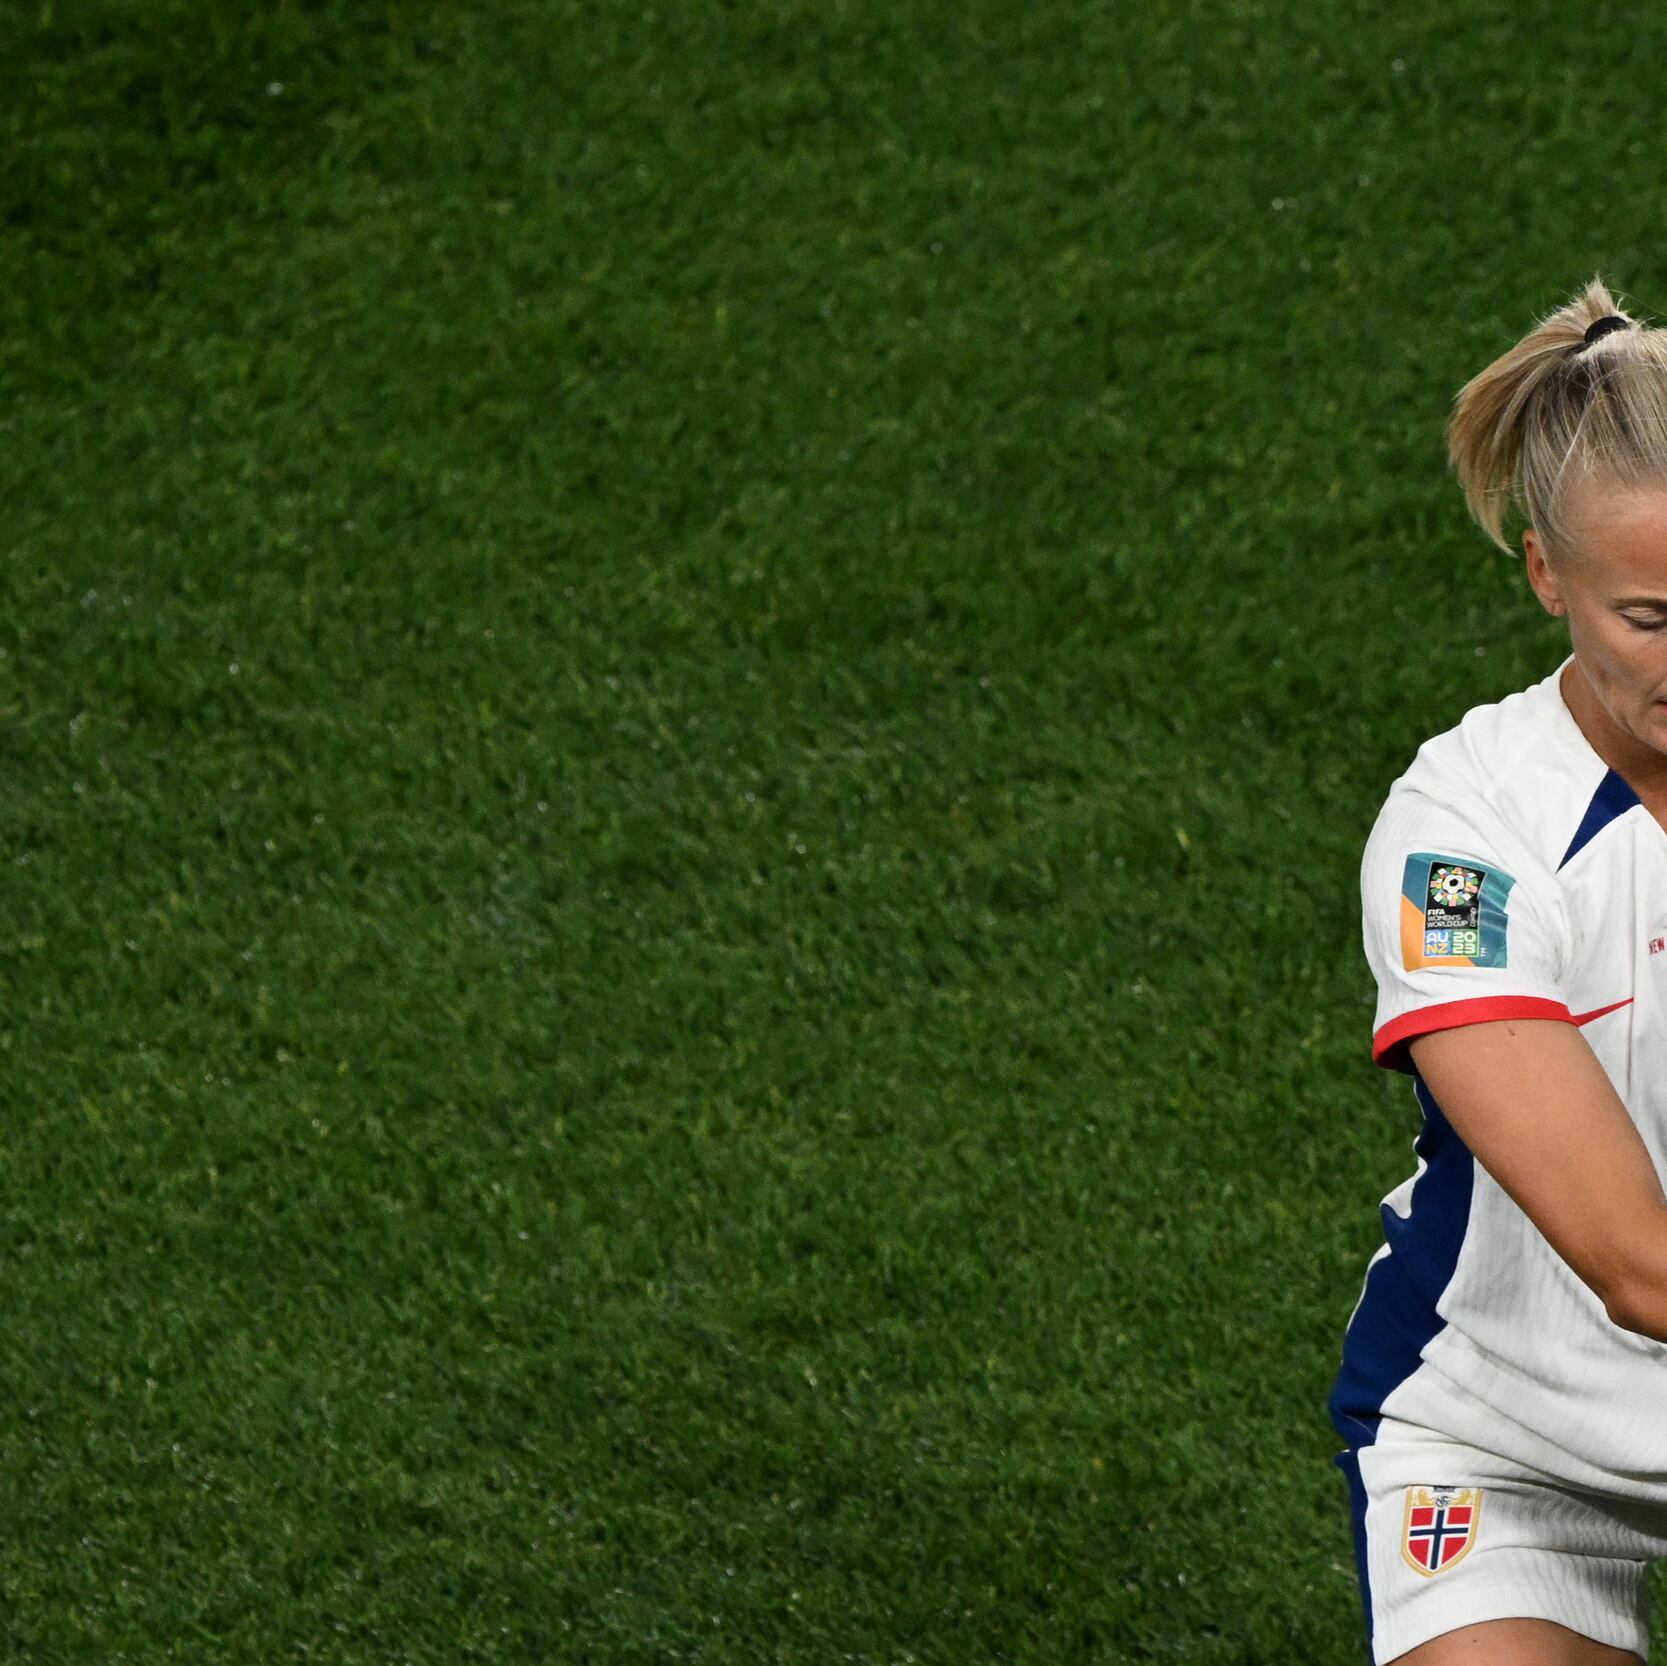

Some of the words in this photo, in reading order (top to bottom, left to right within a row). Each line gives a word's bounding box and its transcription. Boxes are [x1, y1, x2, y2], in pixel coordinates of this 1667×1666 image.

[1427, 914, 1461, 922] WOMEN'S
[1426, 931, 1448, 943] AU
[1453, 931, 1476, 942] 20
[1426, 943, 1448, 954] NZ
[1452, 943, 1476, 954] 23
